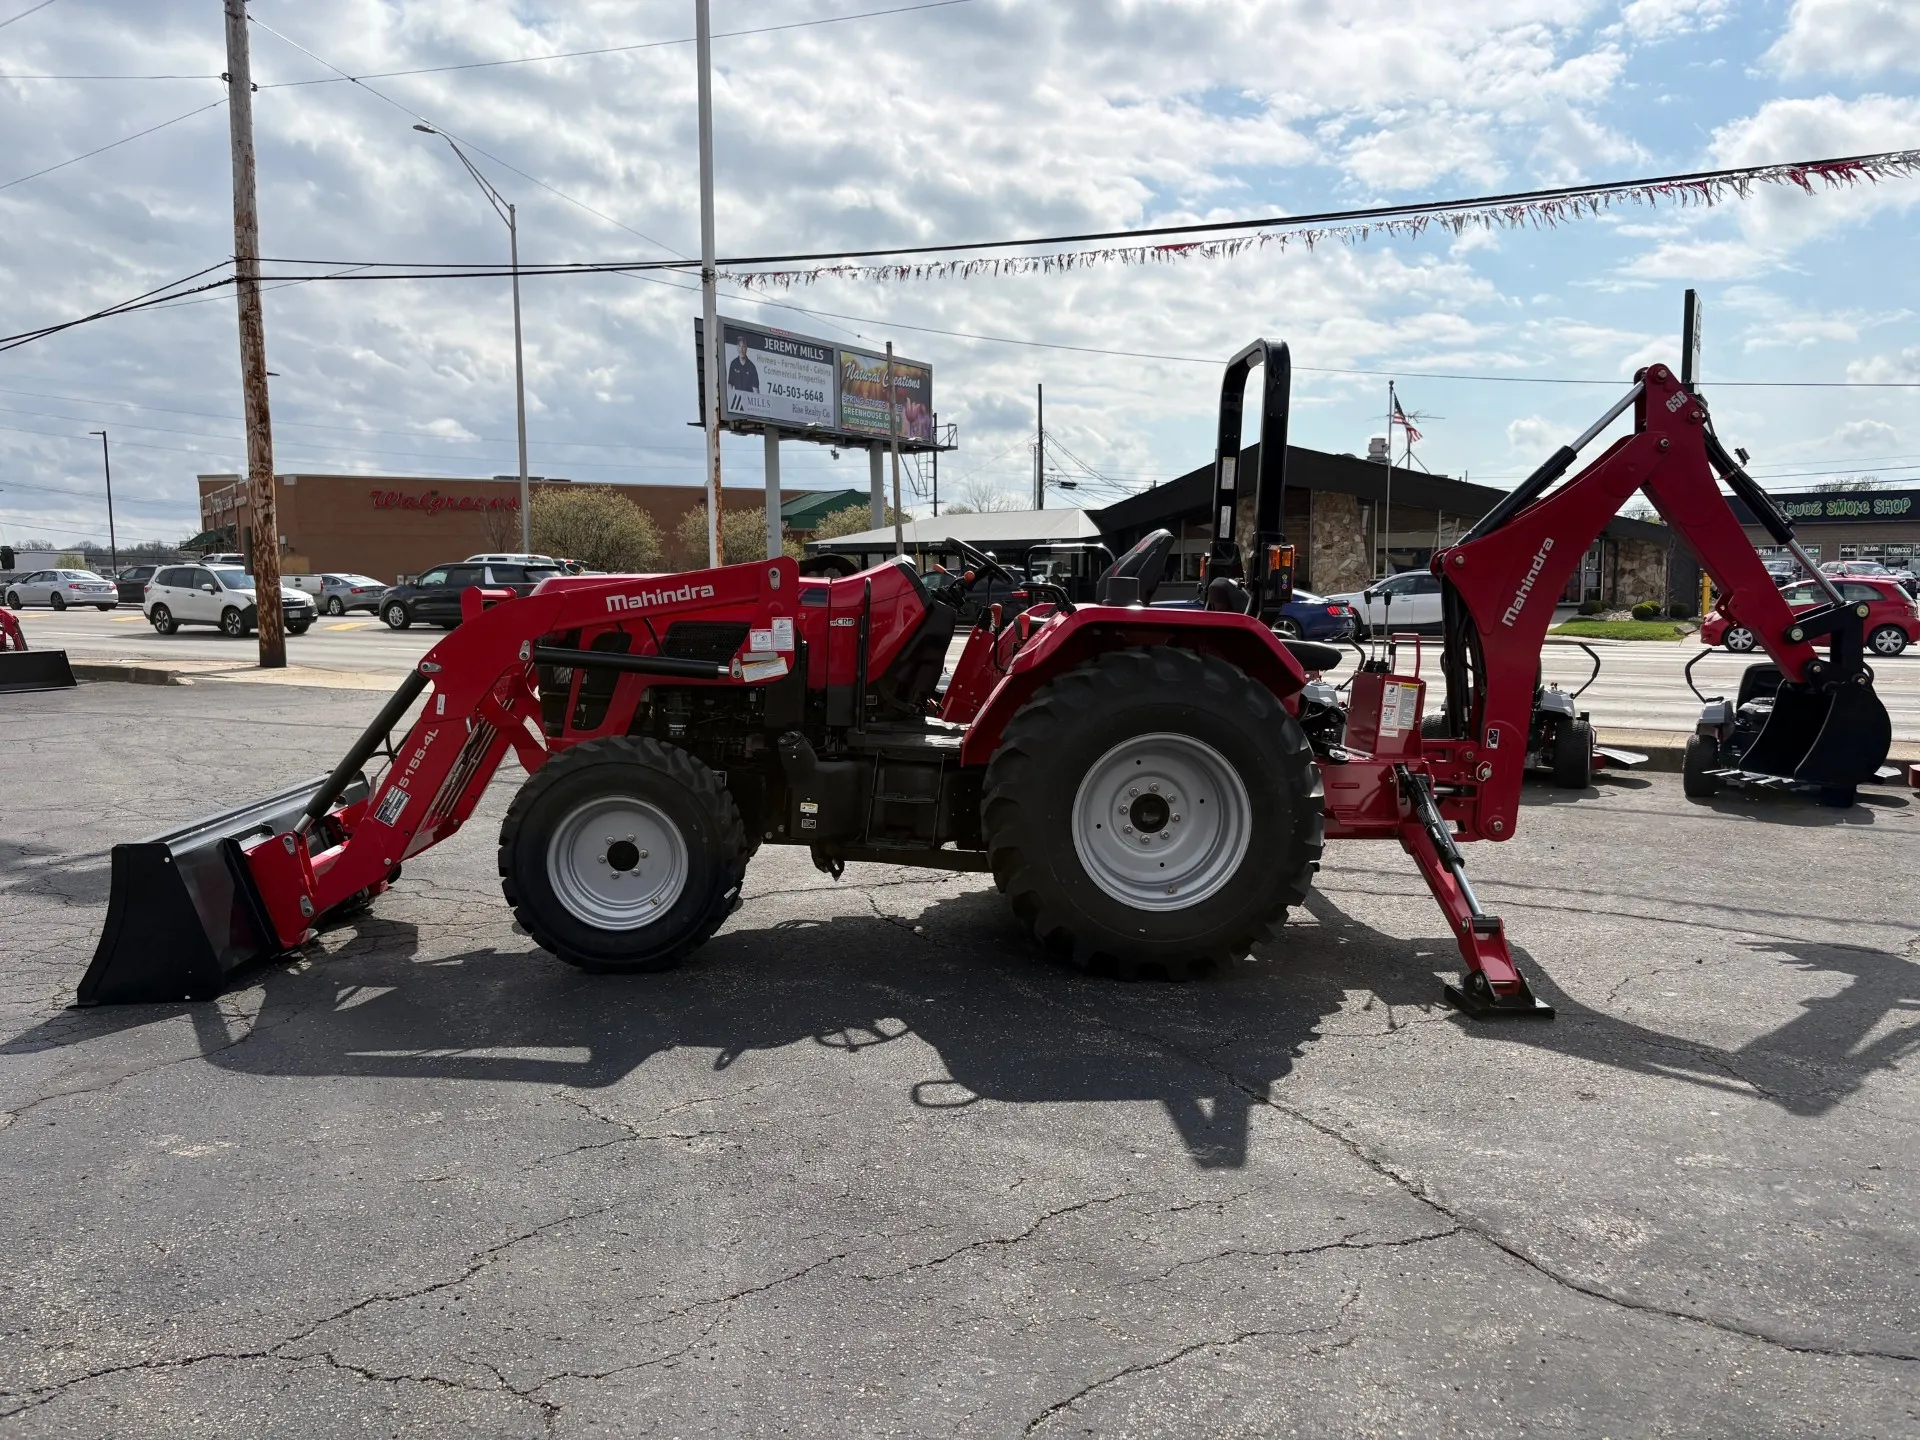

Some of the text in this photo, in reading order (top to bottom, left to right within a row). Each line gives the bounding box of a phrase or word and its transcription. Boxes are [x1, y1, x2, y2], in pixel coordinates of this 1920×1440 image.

[764, 337, 824, 360] JEREMY MILLS
[756, 353, 777, 365] Homes
[763, 365, 826, 385] Commercial Properties
[845, 361, 921, 389] Natural Ceations
[747, 396, 771, 408] MILLS
[766, 382, 824, 403] 740-503-6648
[842, 394, 864, 406] SPRING
[1665, 390, 1689, 413] 65B
[792, 403, 803, 414] Rise
[803, 405, 821, 418] Realty
[843, 406, 882, 420] GREENHOUSE
[370, 490, 517, 516] Walgreens
[1786, 501, 1823, 516] BUDZ
[1873, 497, 1912, 515] SHOP
[1887, 546, 1912, 554] TOBACCO
[1501, 537, 1555, 627] Mahindra
[606, 584, 715, 612] Mahindra
